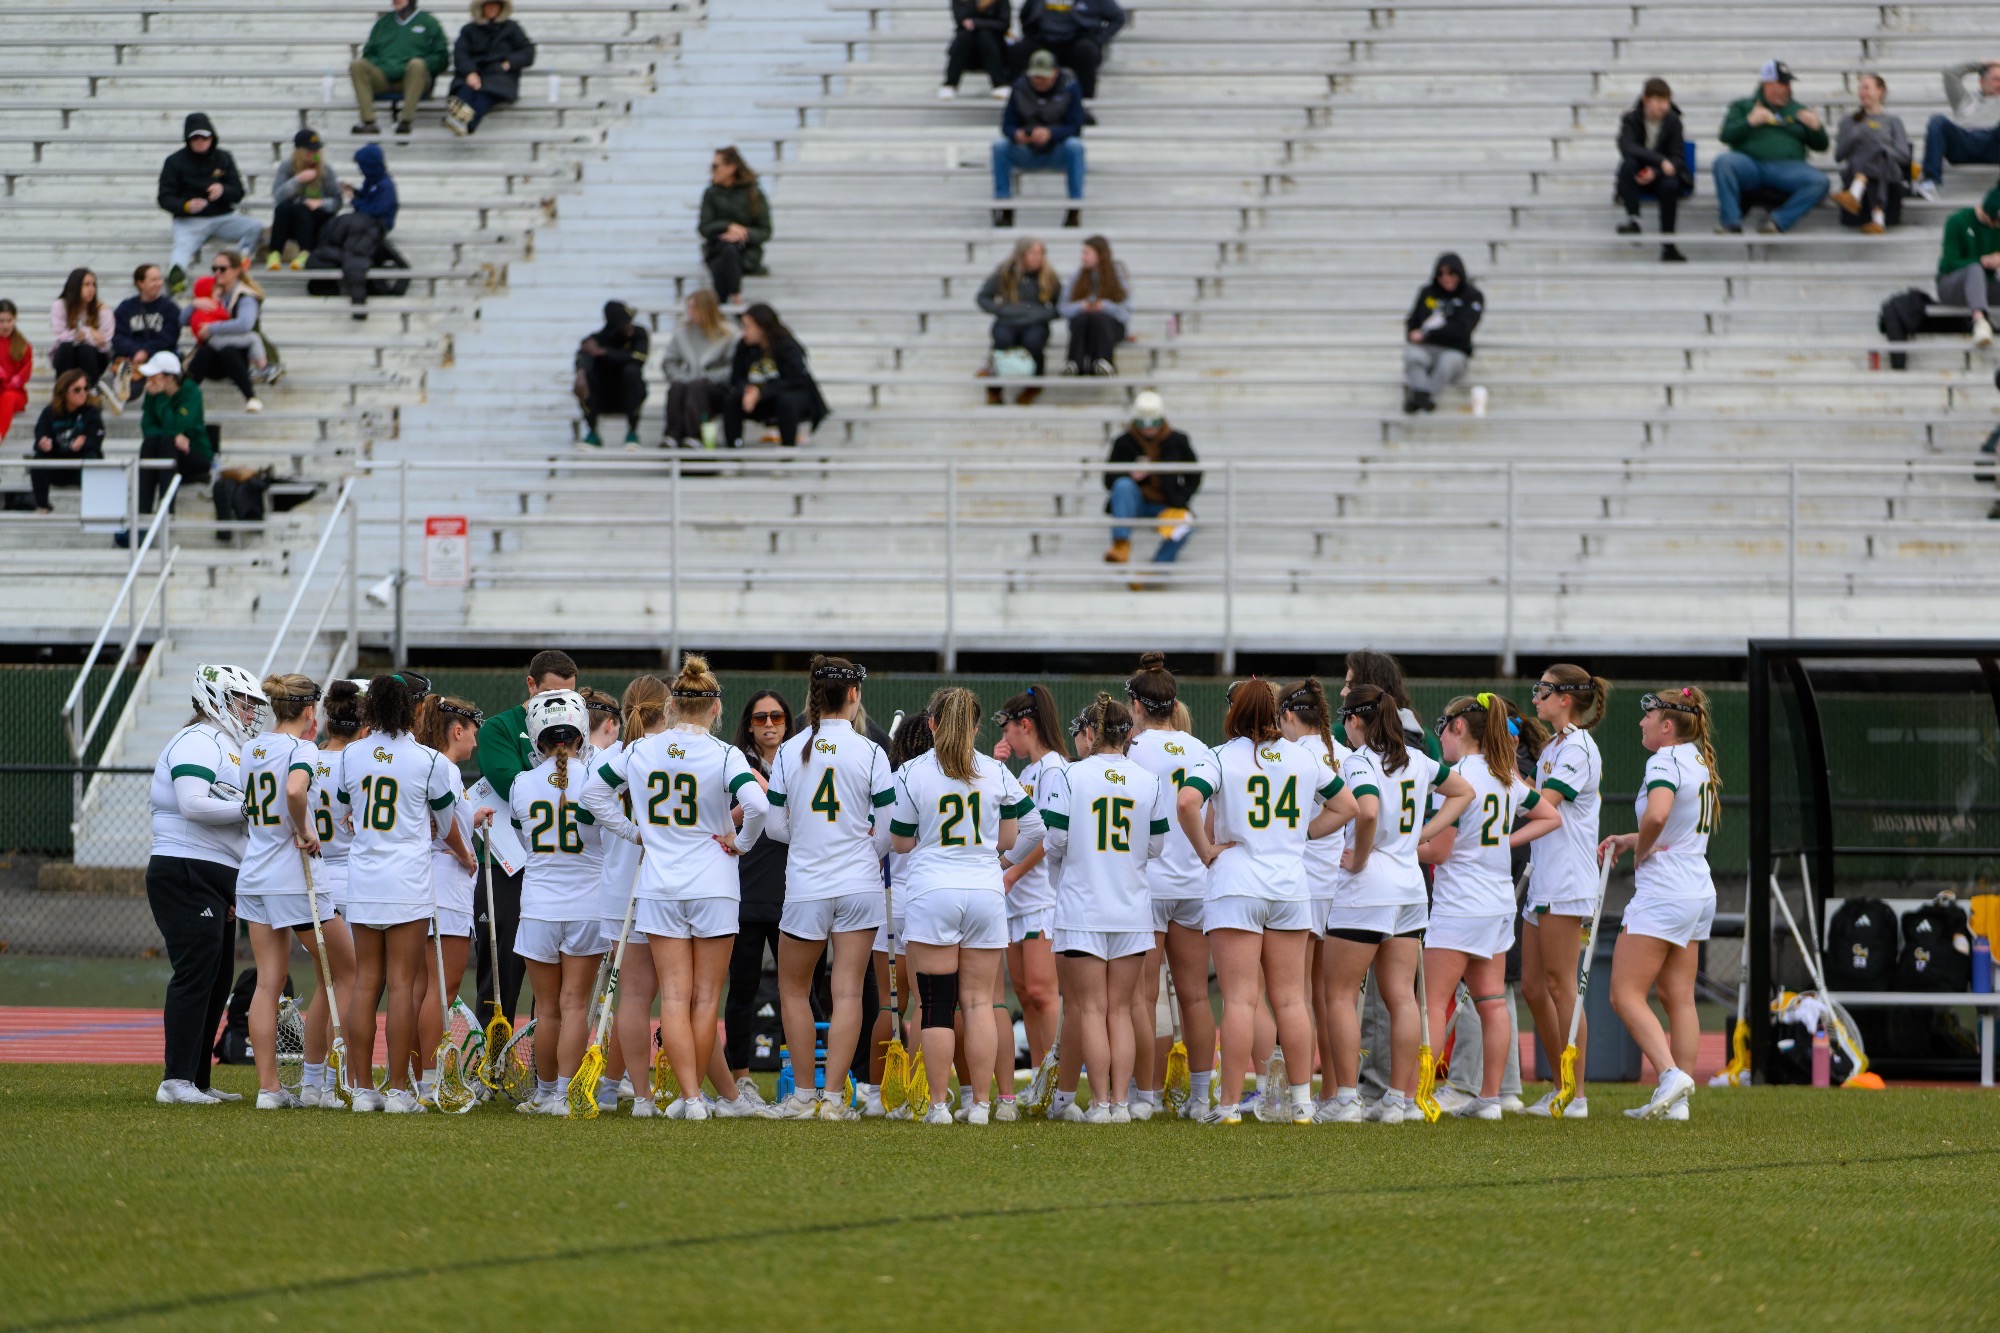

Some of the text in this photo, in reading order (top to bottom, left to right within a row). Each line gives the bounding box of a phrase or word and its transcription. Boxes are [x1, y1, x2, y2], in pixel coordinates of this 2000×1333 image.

[373, 746, 393, 764] GM
[667, 743, 686, 760] GM
[815, 739, 837, 754] GM
[1164, 742, 1185, 755] GM
[1261, 747, 1282, 763] GM
[810, 765, 842, 823] 4
[1104, 769, 1126, 785] GM
[244, 771, 281, 827] 42
[361, 774, 399, 832] 18
[647, 770, 699, 828] 23
[938, 790, 983, 847] 21
[1247, 774, 1301, 830] 34
[529, 800, 585, 854] 26
[1091, 796, 1136, 853] 15
[608, 967, 620, 994] STX
[1578, 970, 1589, 996] STX
